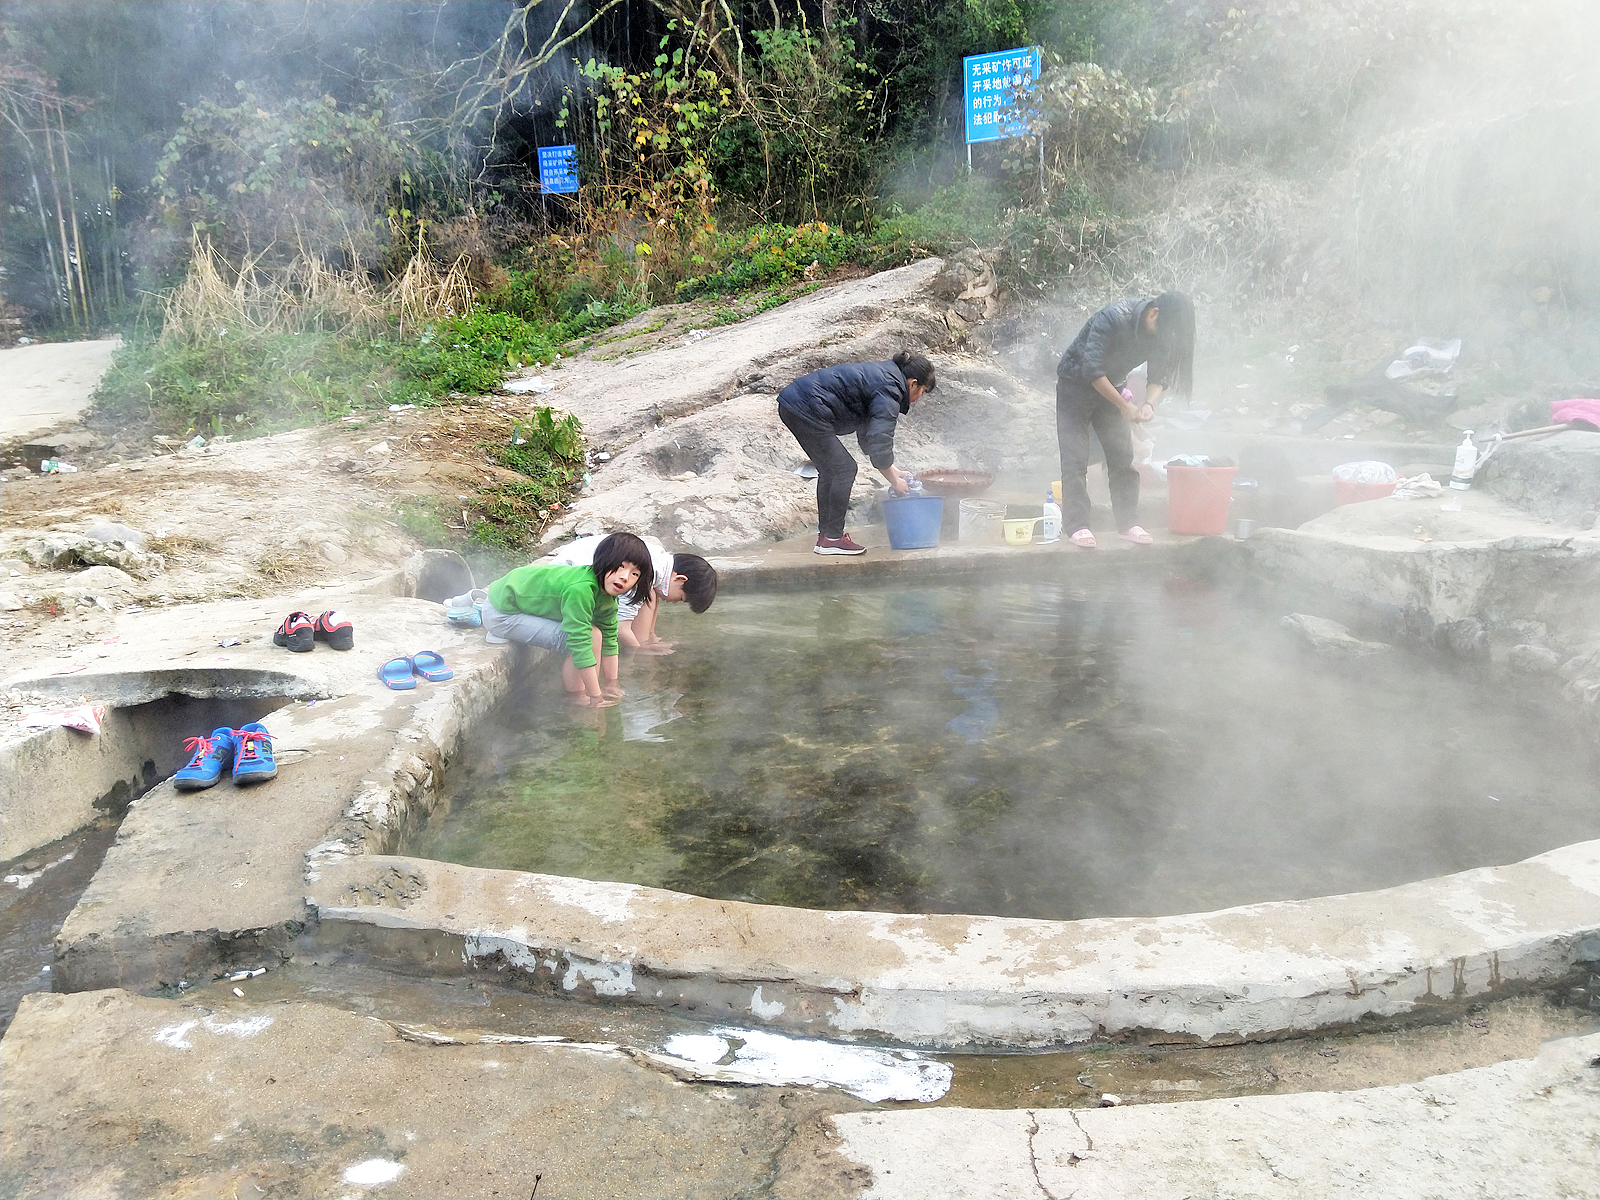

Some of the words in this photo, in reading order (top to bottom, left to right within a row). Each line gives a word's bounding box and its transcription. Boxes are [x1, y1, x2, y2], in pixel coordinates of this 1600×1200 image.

[972, 56, 1032, 76] 无采矿许可证
